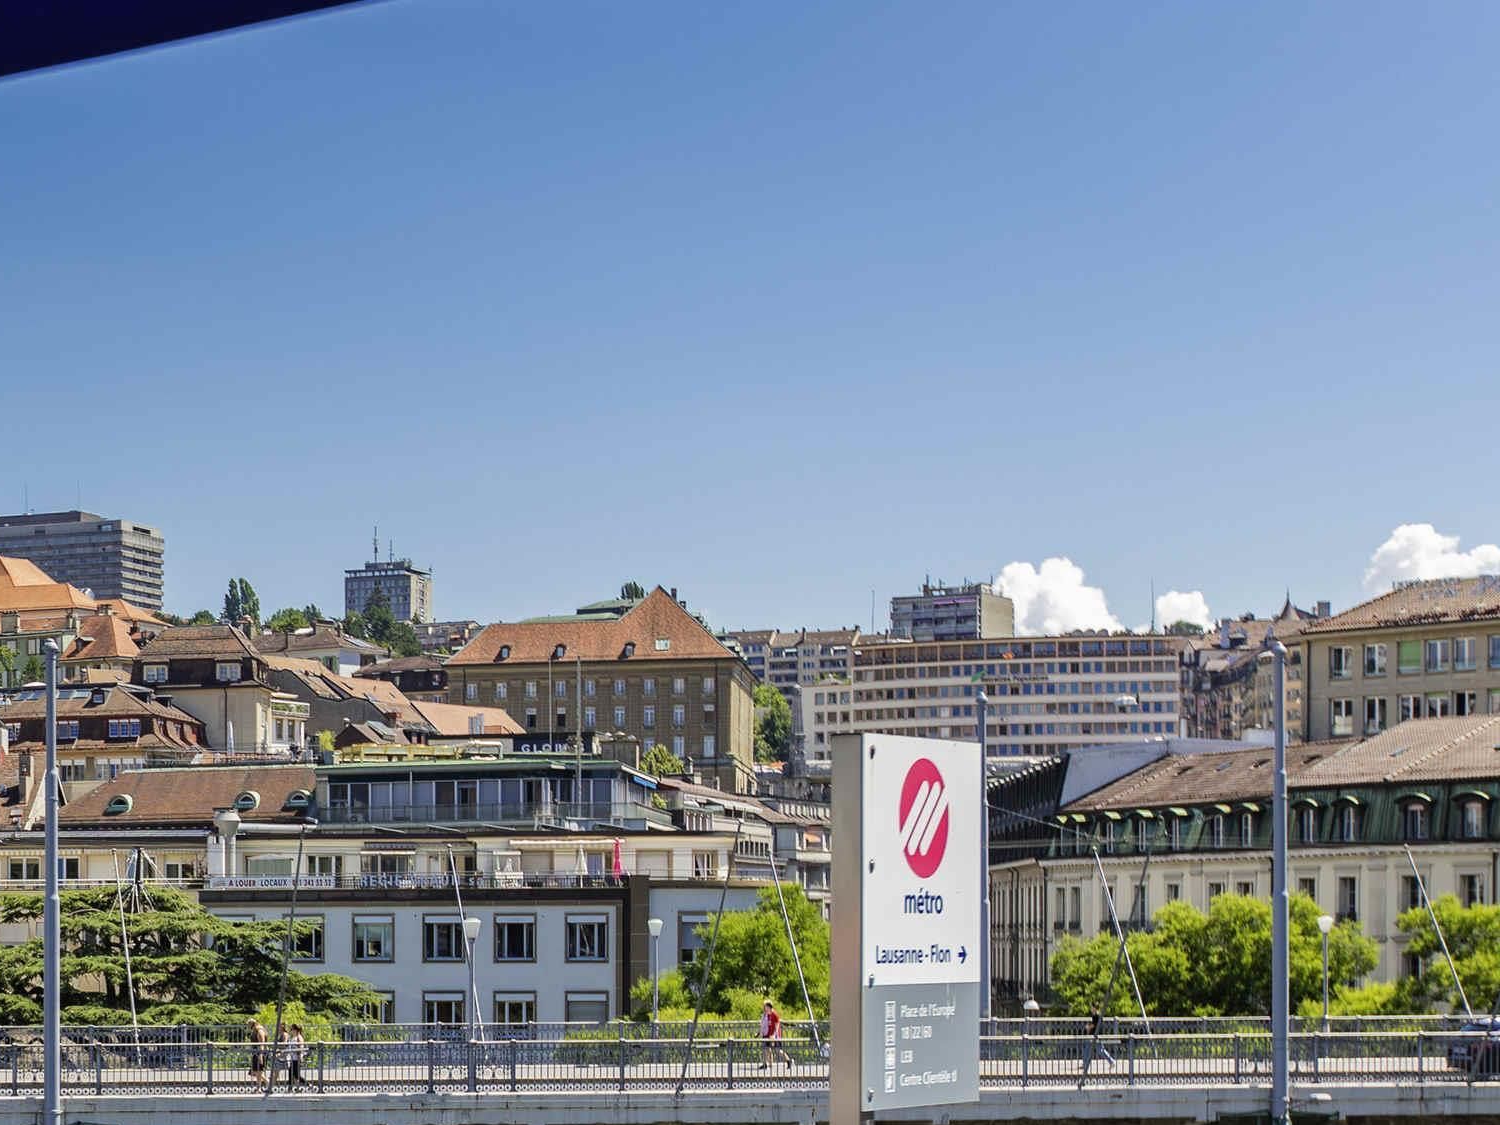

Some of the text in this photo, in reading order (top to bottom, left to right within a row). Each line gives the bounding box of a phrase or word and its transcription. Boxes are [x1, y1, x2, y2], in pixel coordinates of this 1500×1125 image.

[235, 879, 256, 887] LOUER
[260, 879, 288, 888] LOCAUX
[904, 888, 943, 914] métro
[876, 944, 923, 964] Lausanne
[930, 944, 951, 963] Flon
[900, 1004, 918, 1018] Place
[919, 1004, 928, 1017] de
[900, 1073, 922, 1087] Centre
